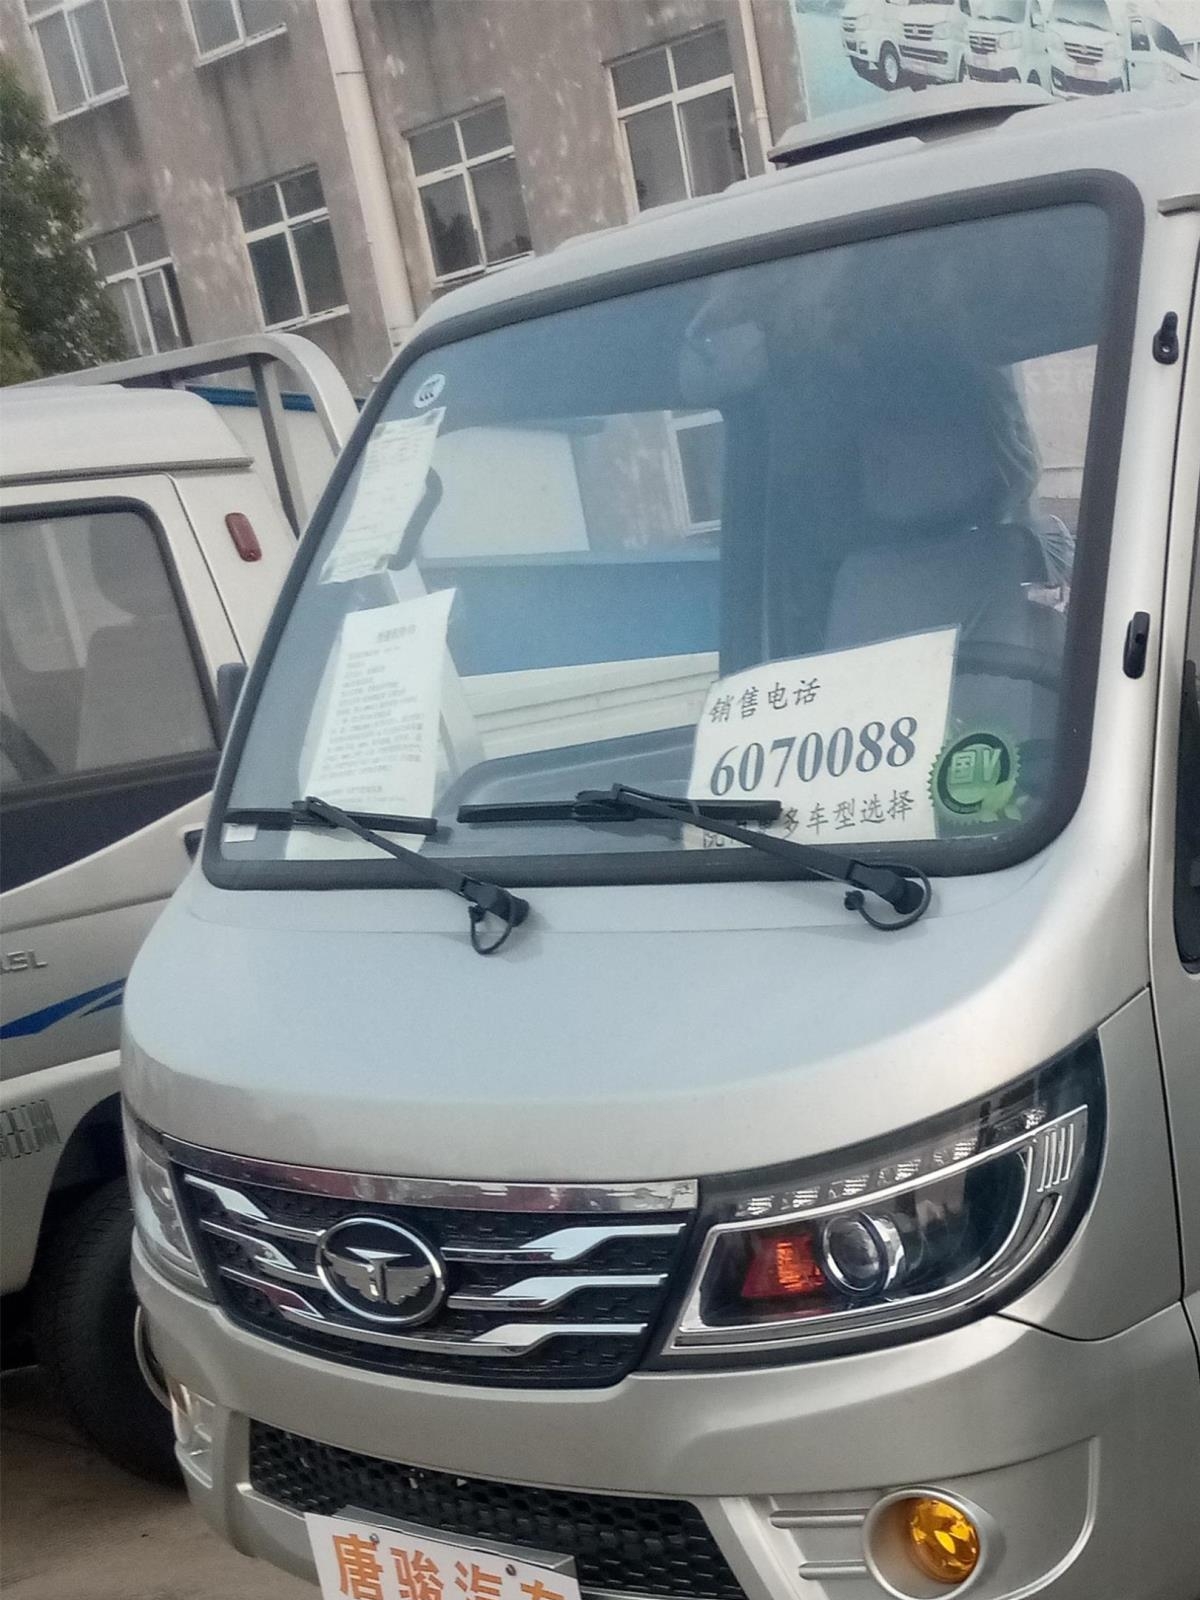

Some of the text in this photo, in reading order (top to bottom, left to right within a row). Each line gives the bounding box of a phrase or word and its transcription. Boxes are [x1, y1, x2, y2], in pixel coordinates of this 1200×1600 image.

[709, 677, 822, 724] 销售电话
[709, 715, 918, 796] 6070088
